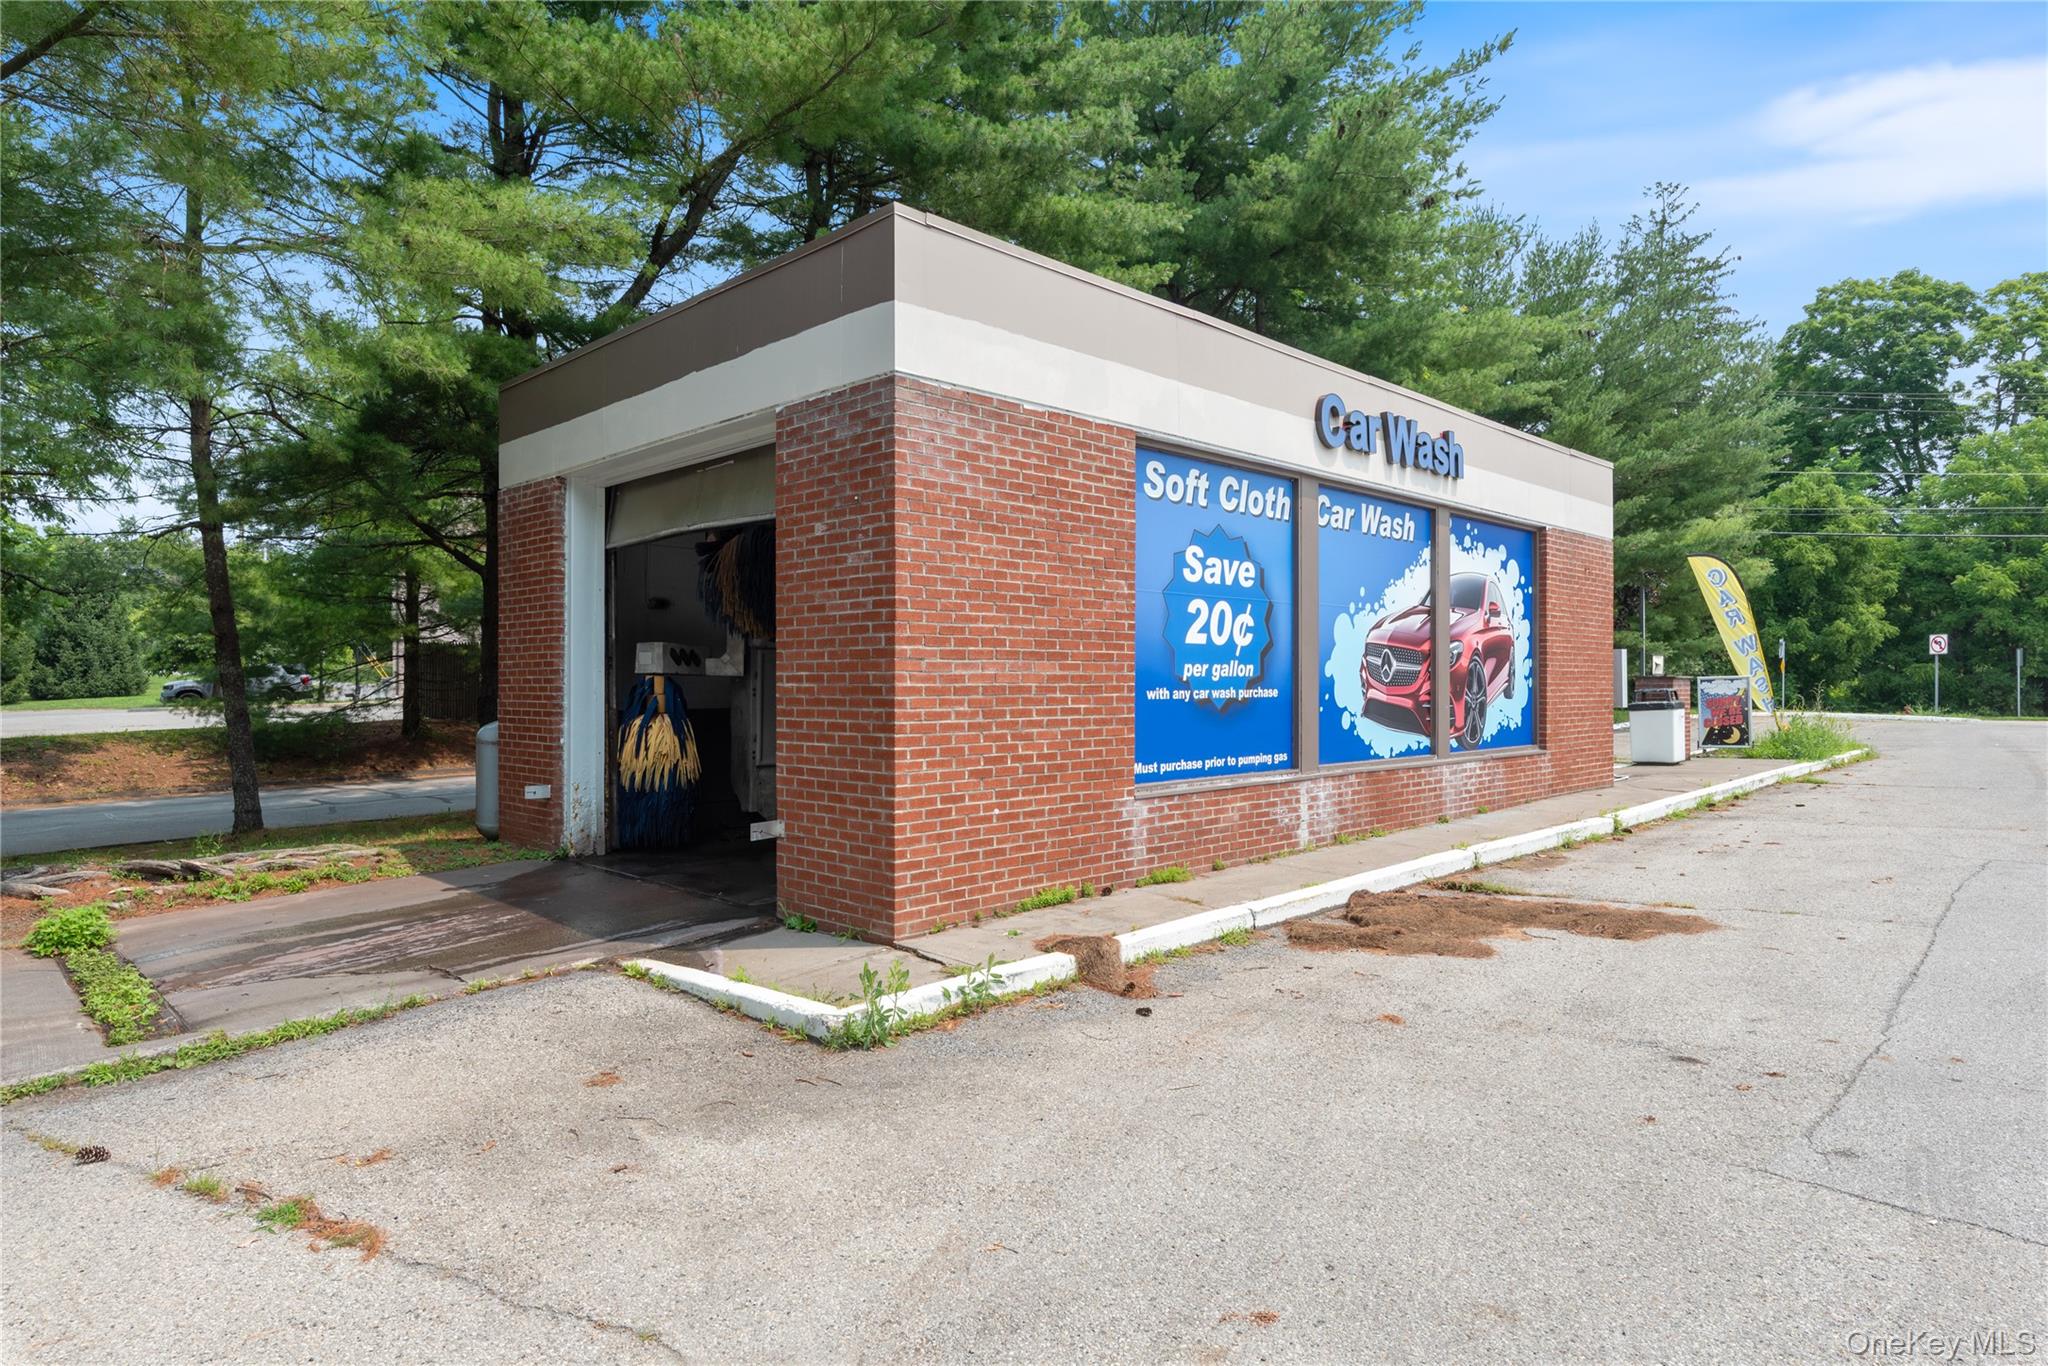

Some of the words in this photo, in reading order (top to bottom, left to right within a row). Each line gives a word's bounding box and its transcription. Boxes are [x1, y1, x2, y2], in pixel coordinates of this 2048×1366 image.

[1315, 393, 1382, 454] Car
[1380, 411, 1464, 479] Wash
[1144, 460, 1209, 507] Soft
[1219, 475, 1291, 521] Cloth
[1318, 494, 1355, 531] Car
[1361, 503, 1415, 542] Wash
[1182, 545, 1256, 588] Save
[1184, 598, 1255, 657] 20¢
[1183, 663, 1209, 681] per
[1211, 660, 1254, 681] gallon
[1147, 687, 1170, 700] with
[1172, 689, 1191, 702] any
[1193, 689, 1209, 699] car
[1212, 687, 1236, 699] wash
[1238, 687, 1279, 700] purchase
[1134, 762, 1158, 774] Must
[1160, 758, 1203, 775] purchase
[1204, 756, 1226, 770] prior
[1227, 755, 1236, 766] to
[1238, 752, 1272, 767] pumping
[1274, 752, 1288, 763] gas
